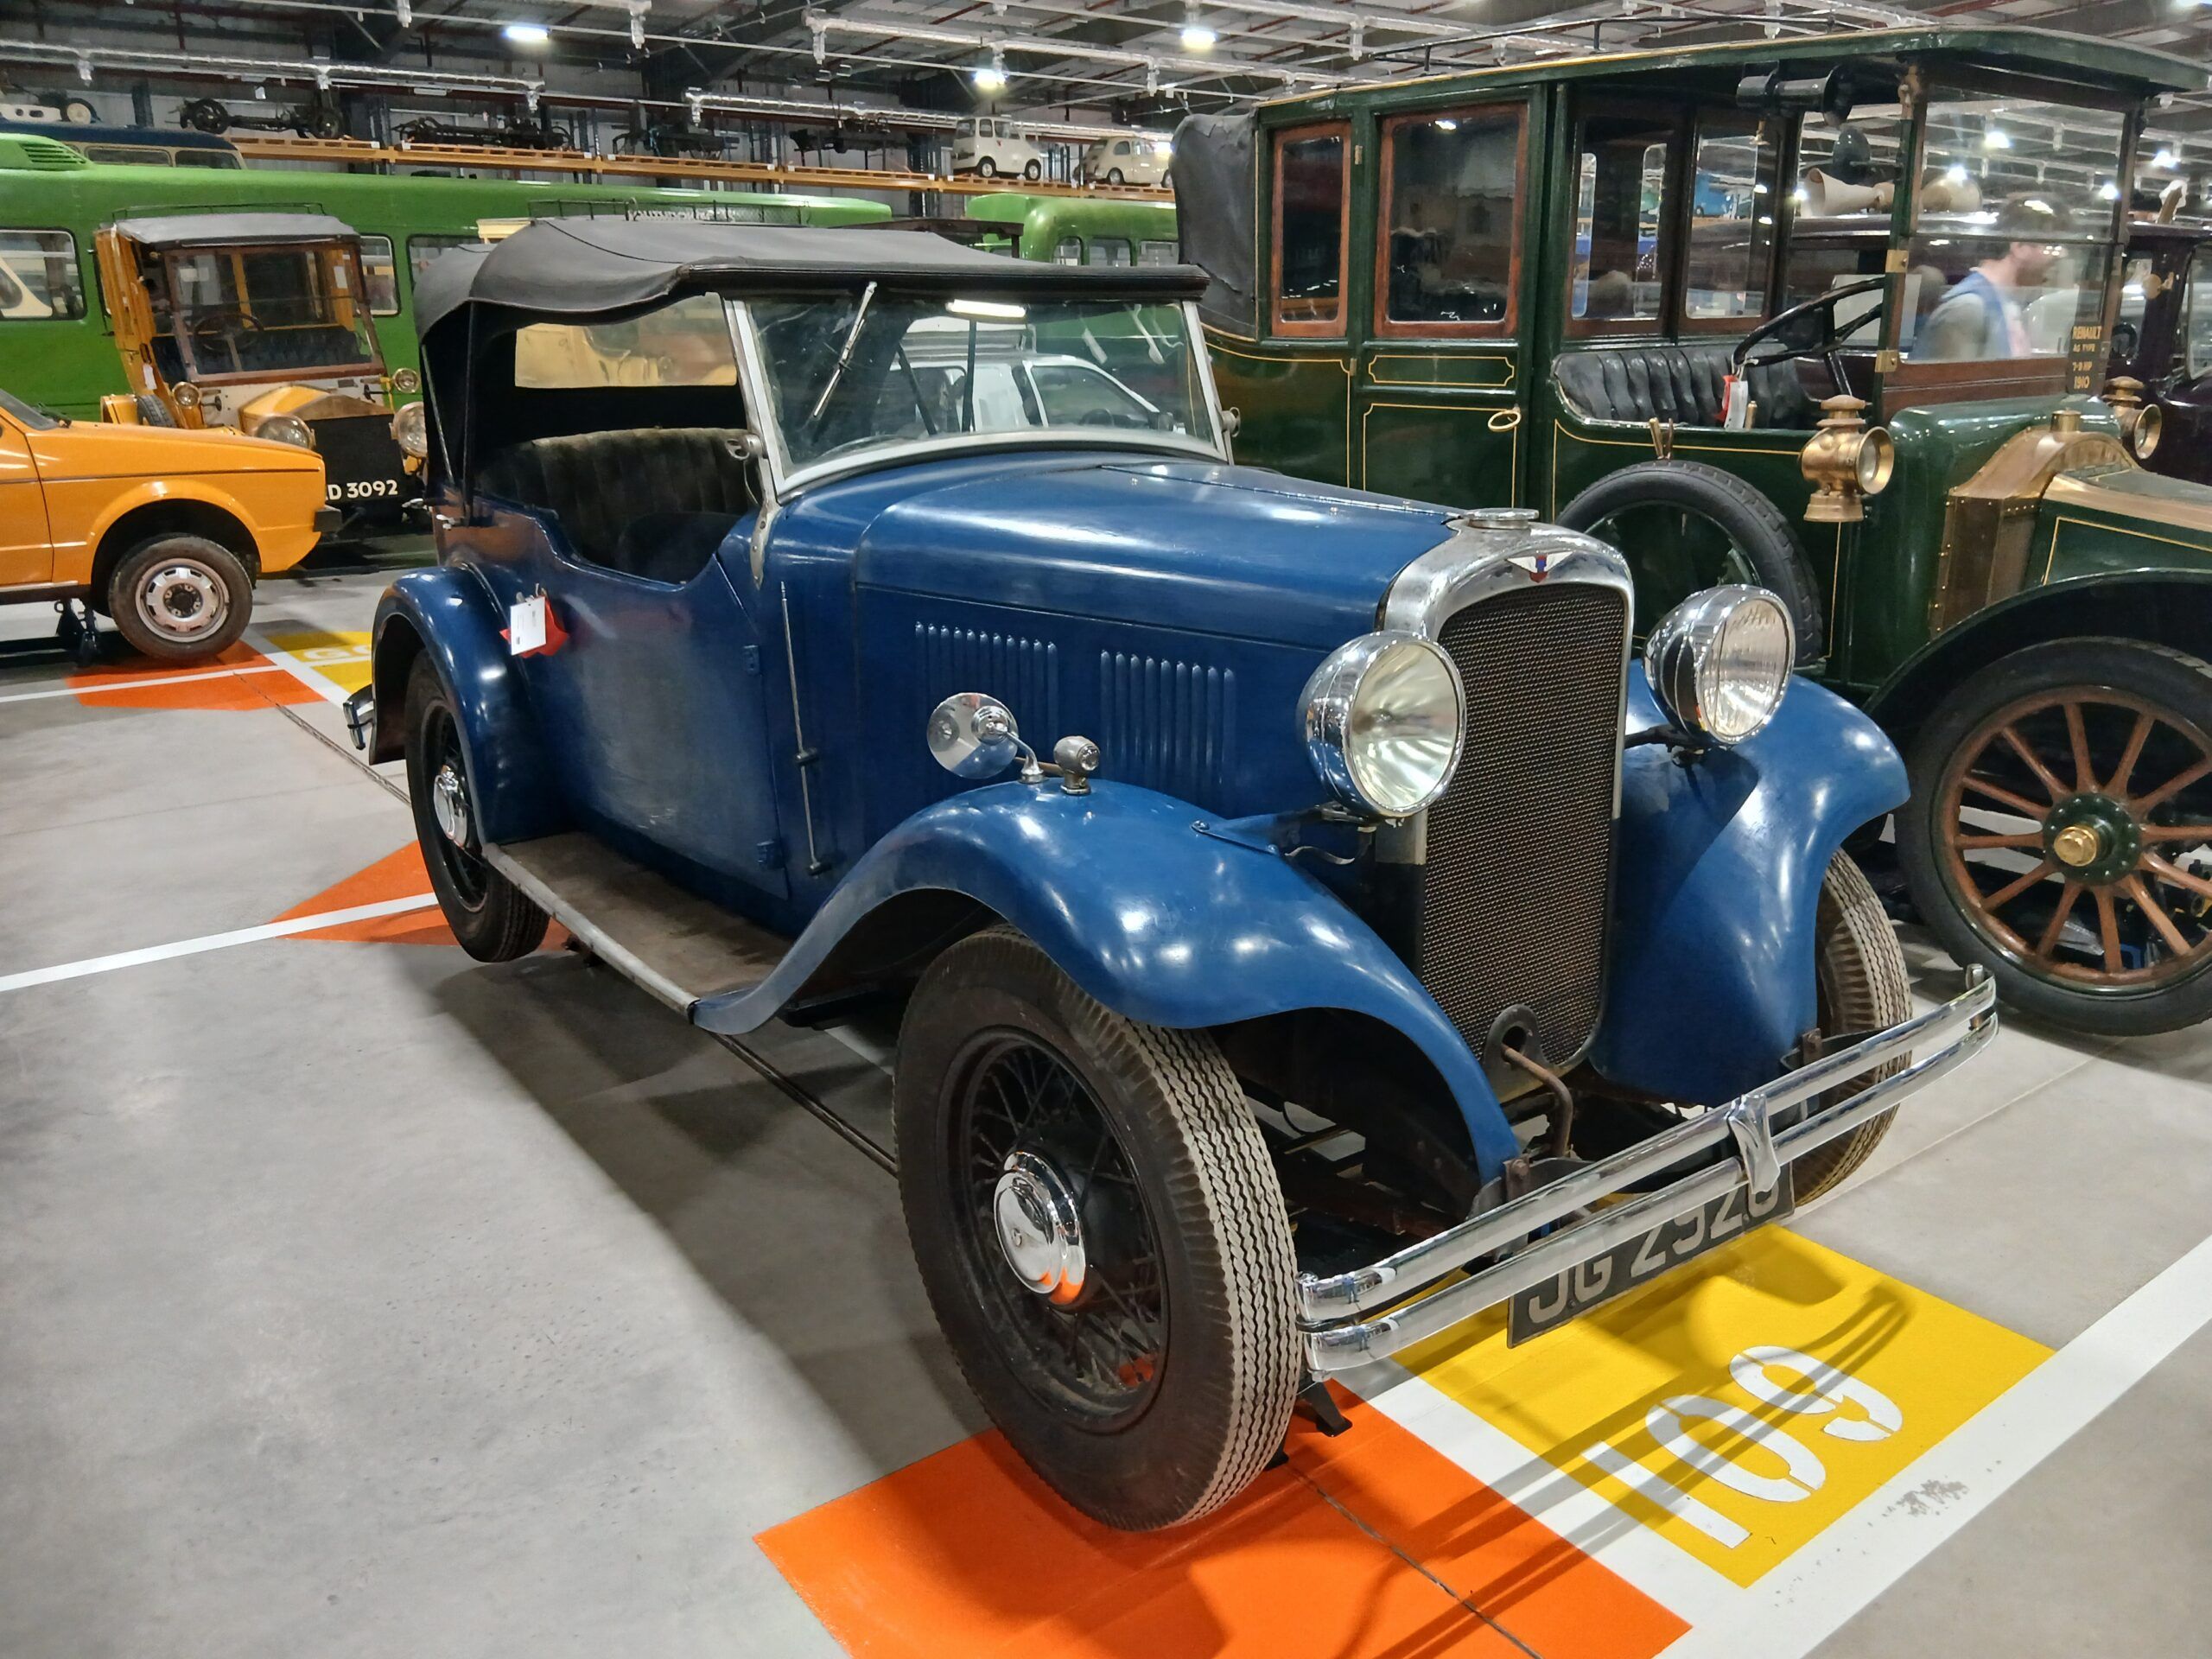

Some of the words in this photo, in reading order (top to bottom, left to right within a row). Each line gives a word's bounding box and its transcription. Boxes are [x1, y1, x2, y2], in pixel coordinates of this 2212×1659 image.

[2072, 325, 2102, 340] RENAULT
[2074, 375, 2090, 390] 1910
[326, 484, 342, 500] D
[346, 480, 398, 499] 3092
[1528, 1255, 1613, 1325] JG
[1580, 1345, 1904, 1550] 109
